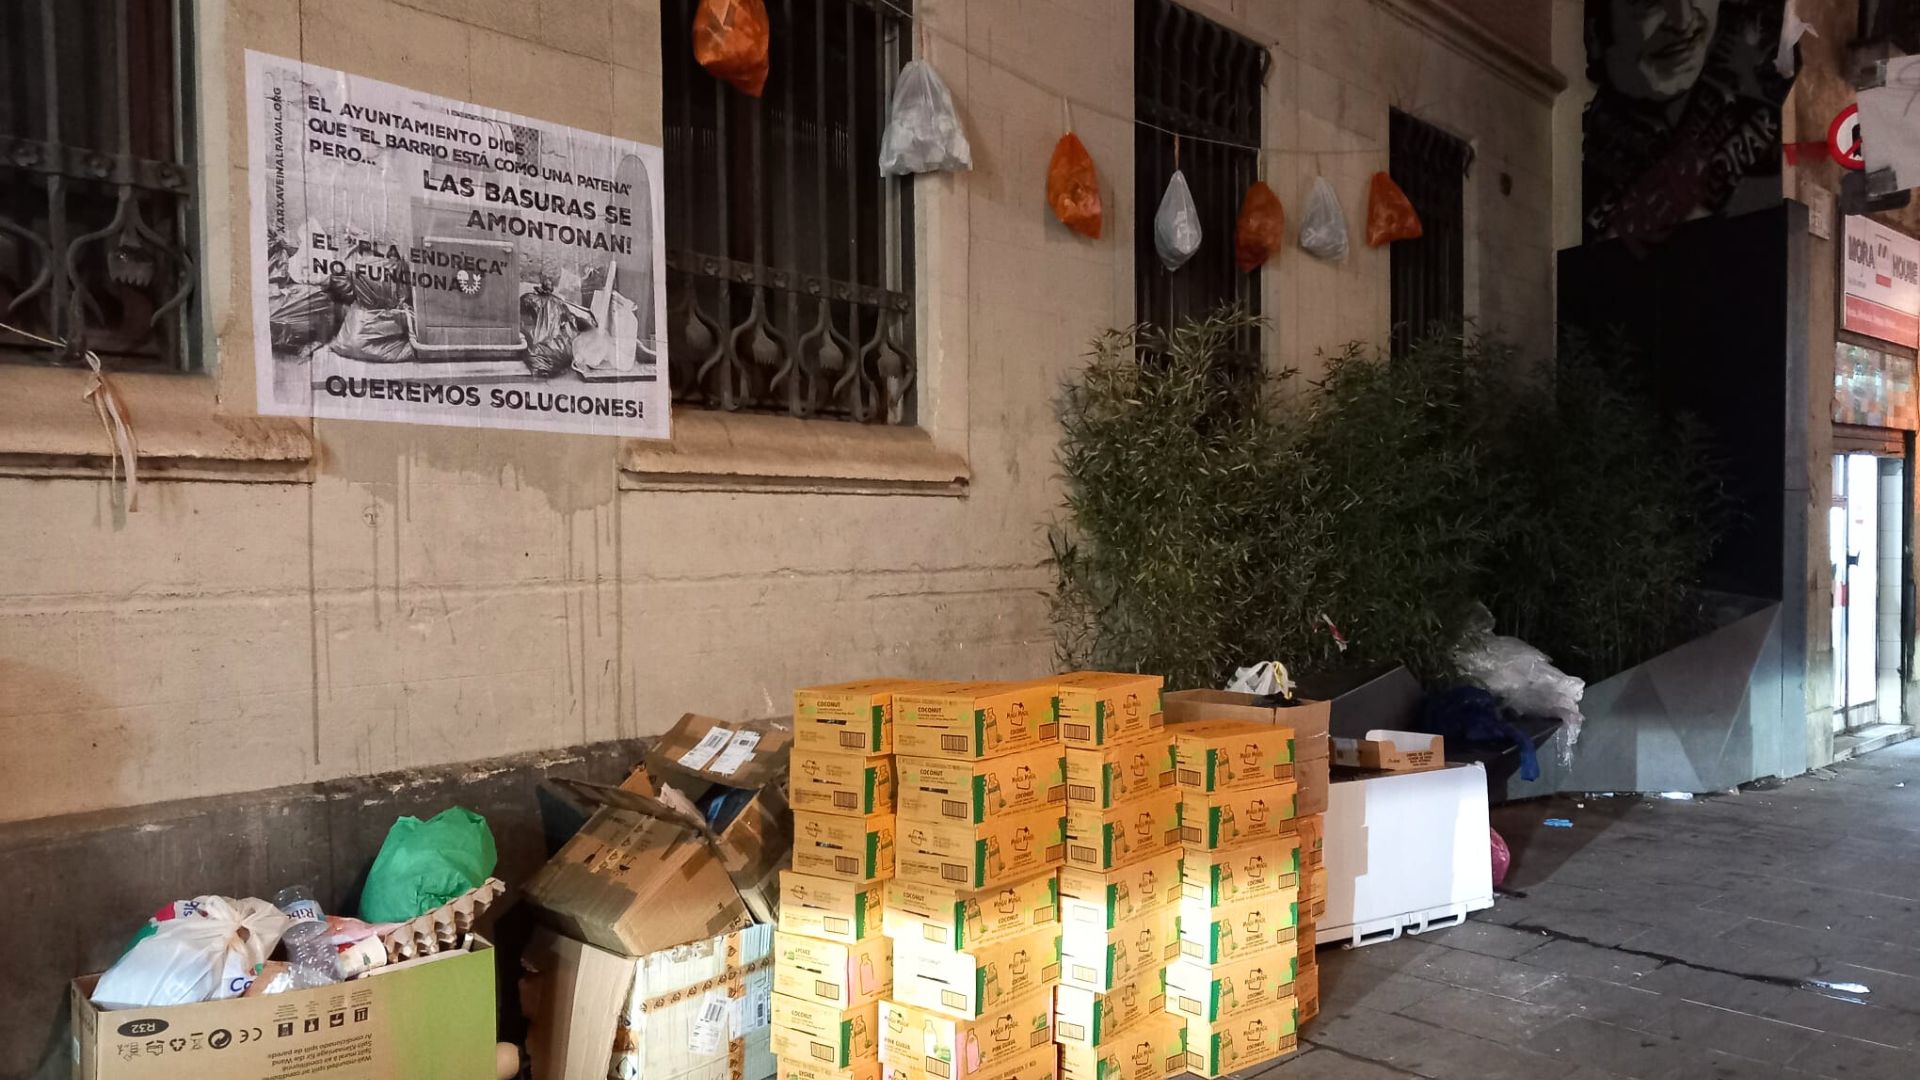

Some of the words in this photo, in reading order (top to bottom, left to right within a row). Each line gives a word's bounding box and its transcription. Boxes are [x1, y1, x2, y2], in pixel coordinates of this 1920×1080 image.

[308, 95, 332, 113] EL
[340, 103, 482, 146] AYUNTAMIENTO
[488, 136, 526, 156] DICE
[274, 88, 286, 233] XARXAVEINALRAVAL.ORG
[308, 117, 347, 138] QUE
[386, 134, 448, 159] BARRIO
[452, 151, 490, 168] ESTÁ
[494, 158, 538, 178] COMO
[542, 168, 573, 185] UNA
[309, 139, 376, 166] PERO...
[423, 171, 474, 198] LAS
[485, 182, 596, 220] BASURAS
[604, 205, 632, 226] SE
[312, 232, 338, 252] EL
[466, 210, 632, 254] AMONTONAN!
[312, 258, 346, 276] NO
[355, 264, 462, 292] FUNCIONA
[325, 376, 480, 406] QUEREMOS
[490, 389, 644, 418] SOLUCIONES!
[918, 706, 942, 714] COCONUT
[920, 768, 943, 776] COCONUT
[130, 1022, 156, 1034] R32
